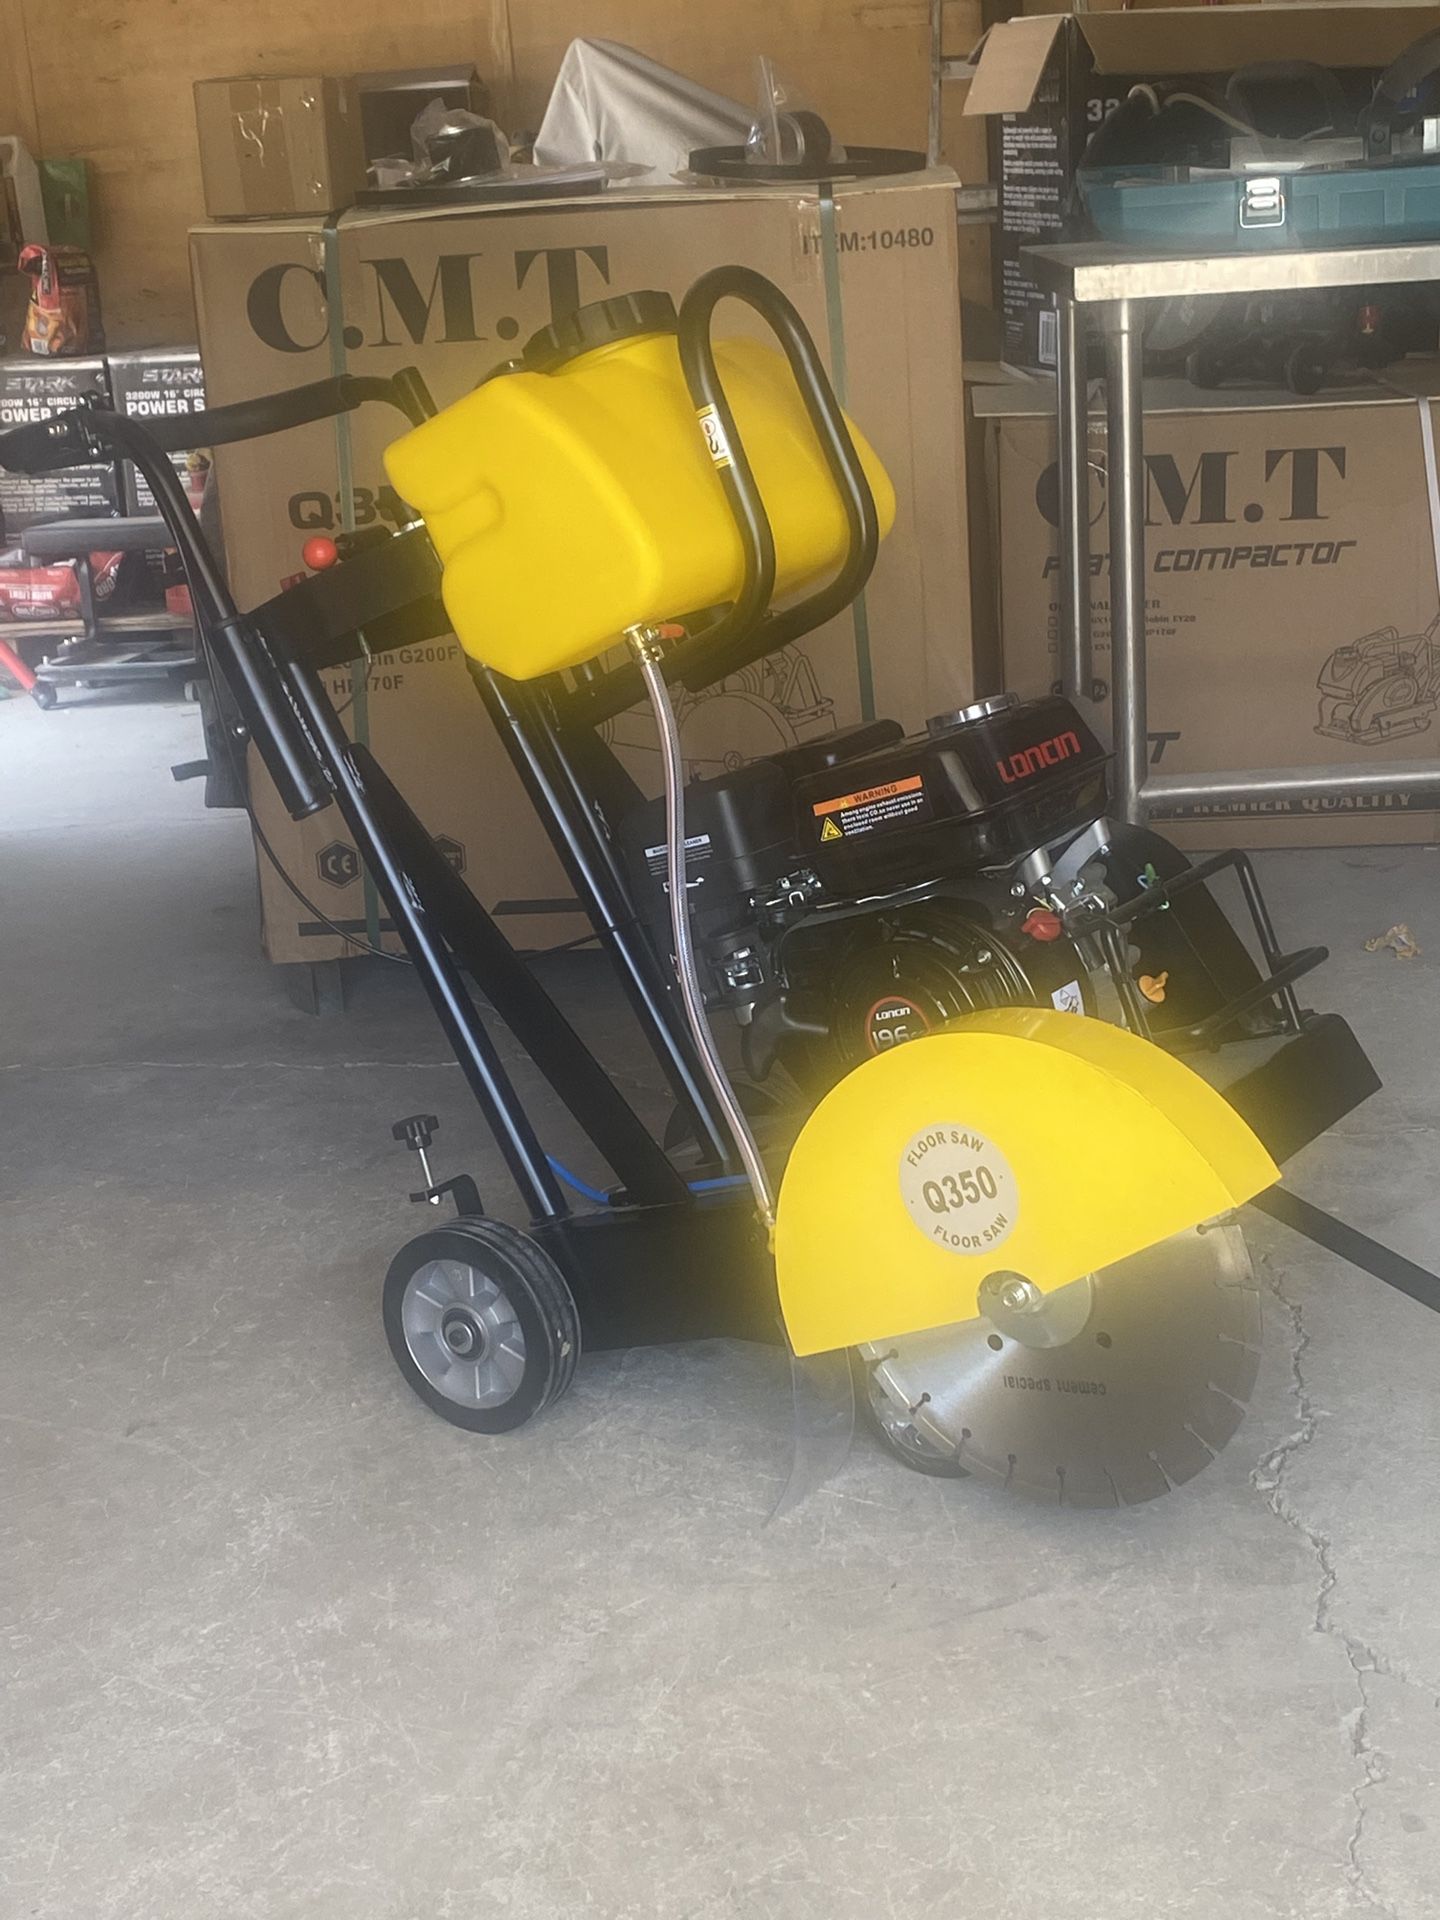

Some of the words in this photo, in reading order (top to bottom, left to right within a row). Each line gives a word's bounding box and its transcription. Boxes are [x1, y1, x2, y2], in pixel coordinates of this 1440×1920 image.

[803, 227, 934, 255] ITM:10480
[5, 375, 76, 393] STARK
[142, 367, 204, 384] STAR
[125, 391, 160, 401] 3200W
[126, 400, 189, 416] POWER
[1036, 446, 1347, 528] CM.T
[399, 645, 458, 664] G200F
[853, 784, 898, 803] WARNING
[907, 1131, 947, 1168] FLOOR
[950, 1130, 984, 1152] SAW
[922, 1165, 998, 1214] Q350
[933, 1224, 982, 1249] FLOOR
[982, 1212, 1009, 1242] SAW
